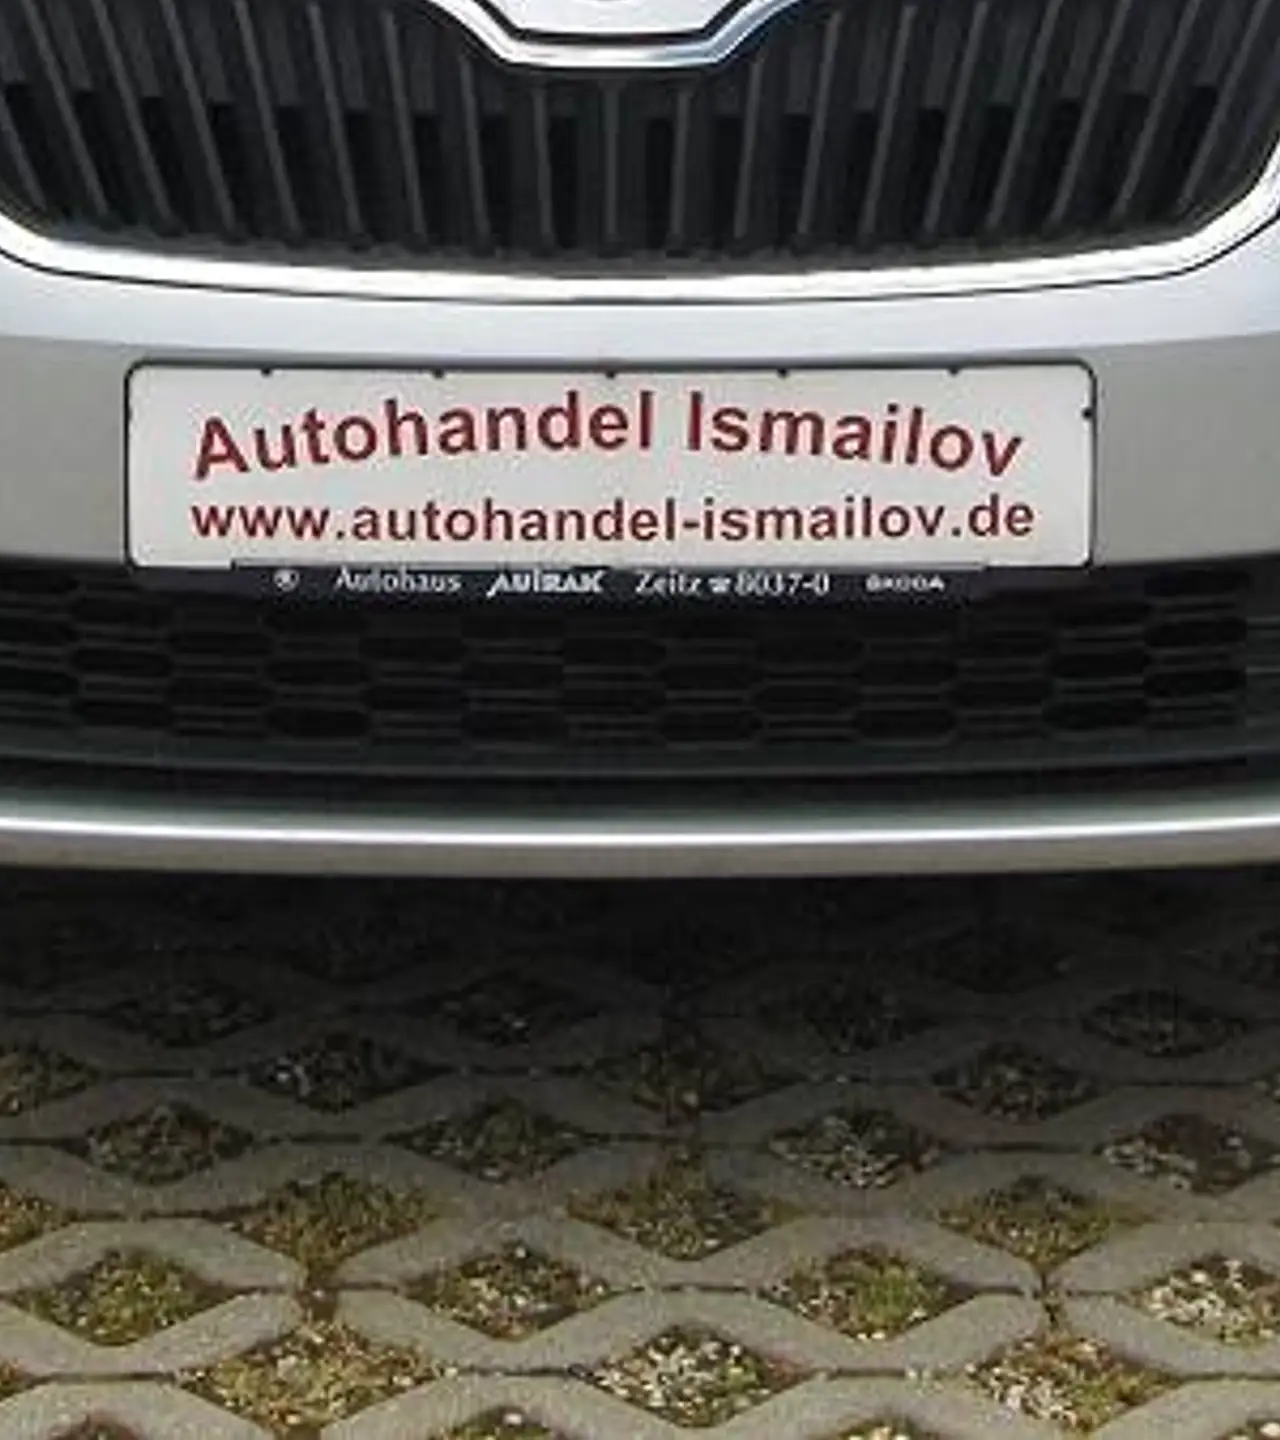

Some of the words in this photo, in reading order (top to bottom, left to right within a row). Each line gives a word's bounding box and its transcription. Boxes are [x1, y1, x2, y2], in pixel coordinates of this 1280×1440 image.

[194, 390, 654, 480] Autohandel
[687, 390, 1024, 478] Ismailov
[191, 494, 1036, 542] www.autohandel-ismailov.de
[335, 564, 462, 594] Autohaus
